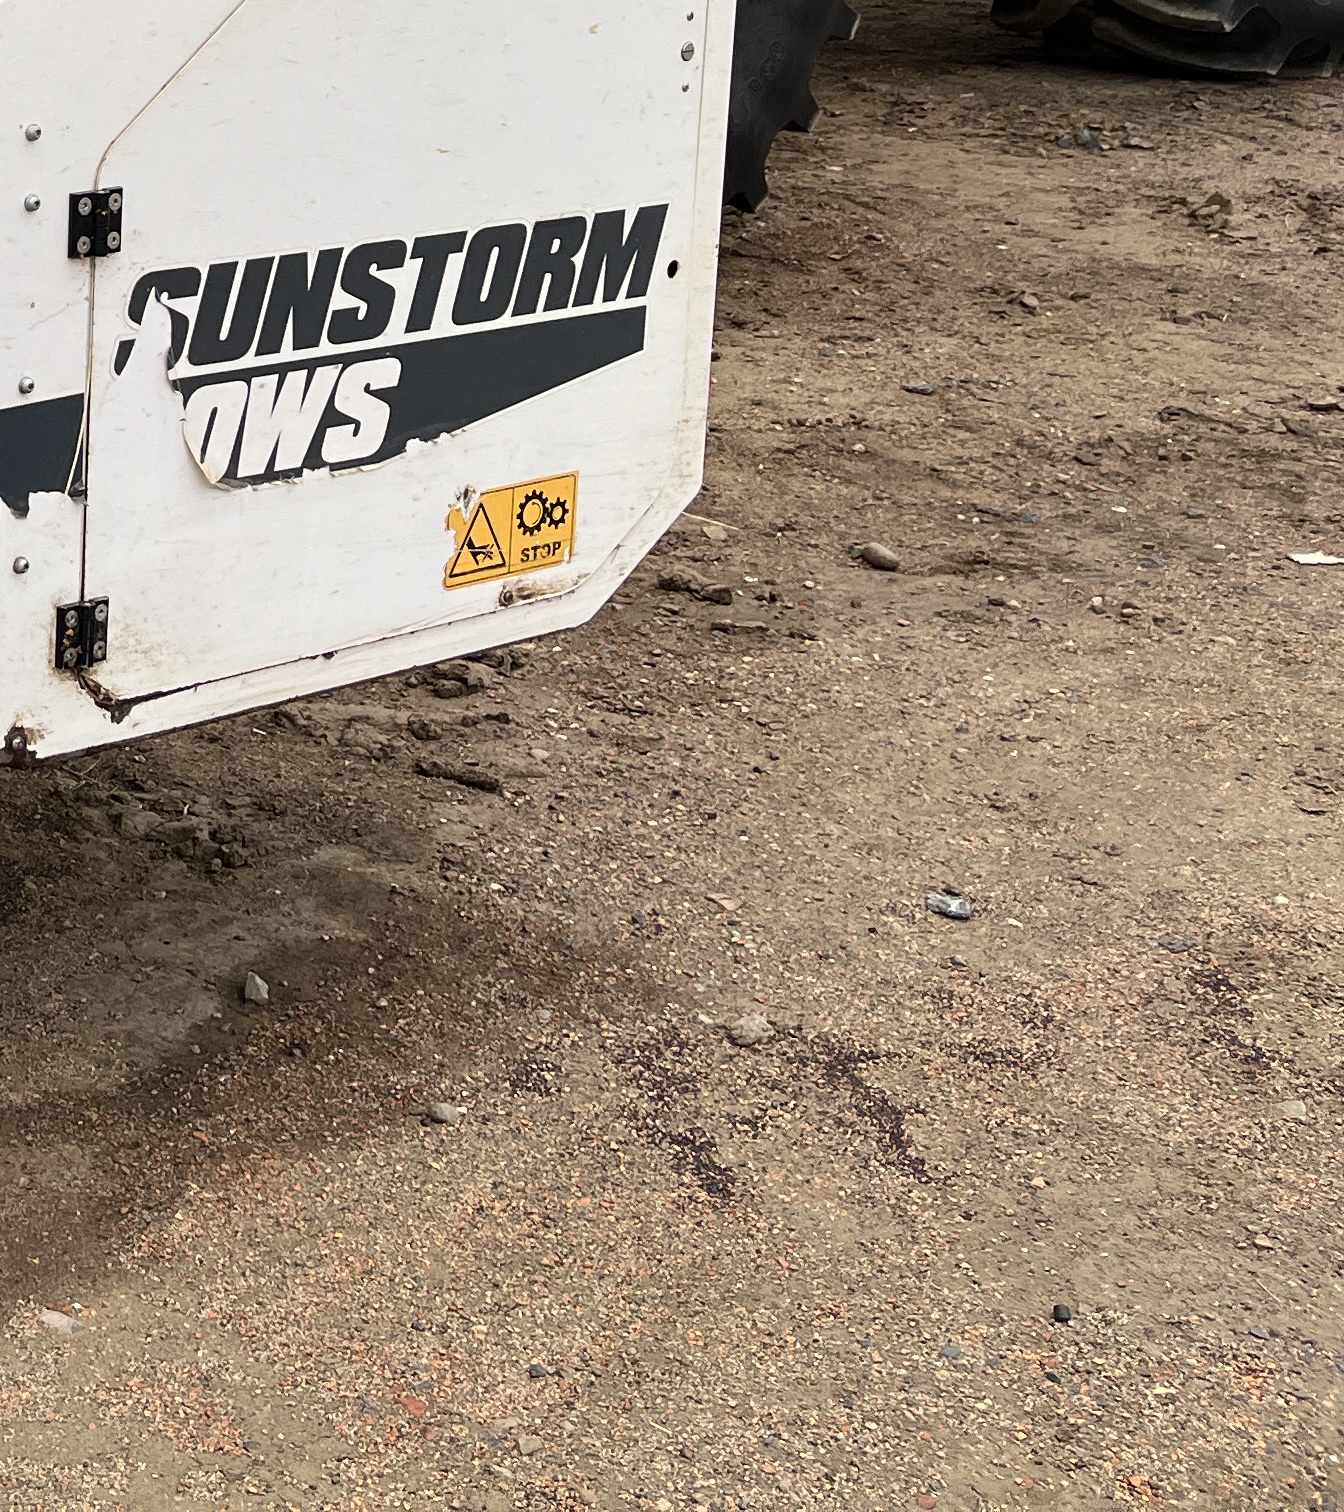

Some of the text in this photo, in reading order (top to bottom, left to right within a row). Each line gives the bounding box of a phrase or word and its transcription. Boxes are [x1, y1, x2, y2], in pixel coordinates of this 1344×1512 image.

[114, 202, 670, 376] SUNSTORM
[183, 356, 402, 484] OWS
[519, 541, 562, 563] STOP
